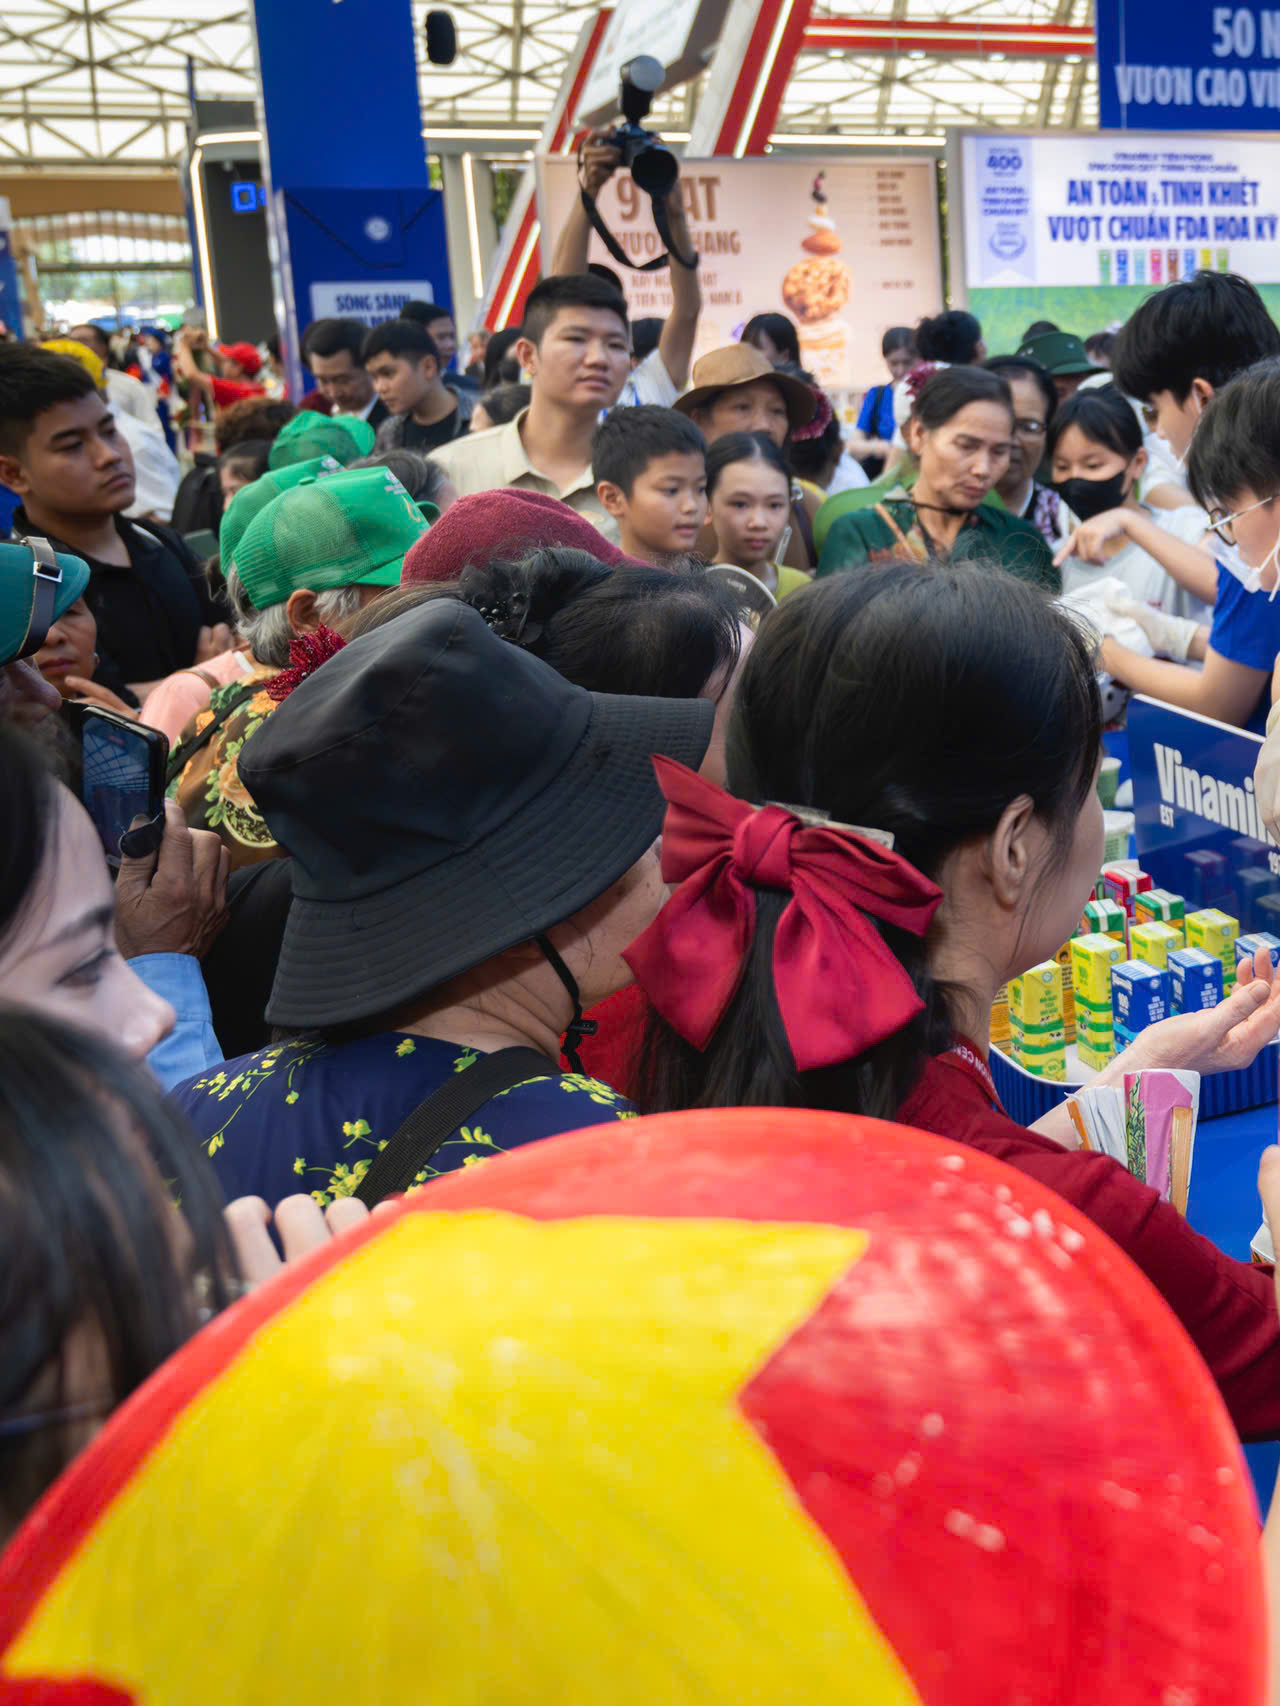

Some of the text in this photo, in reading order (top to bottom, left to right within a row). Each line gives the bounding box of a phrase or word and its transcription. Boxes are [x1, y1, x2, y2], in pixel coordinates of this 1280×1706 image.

[1213, 8, 1256, 58] 50
[1198, 68, 1247, 107] CAO
[616, 175, 640, 222] 9
[1067, 180, 1093, 206] AN
[1175, 215, 1210, 242] FDA
[1213, 215, 1250, 242] HOA
[1160, 804, 1174, 829] EST
